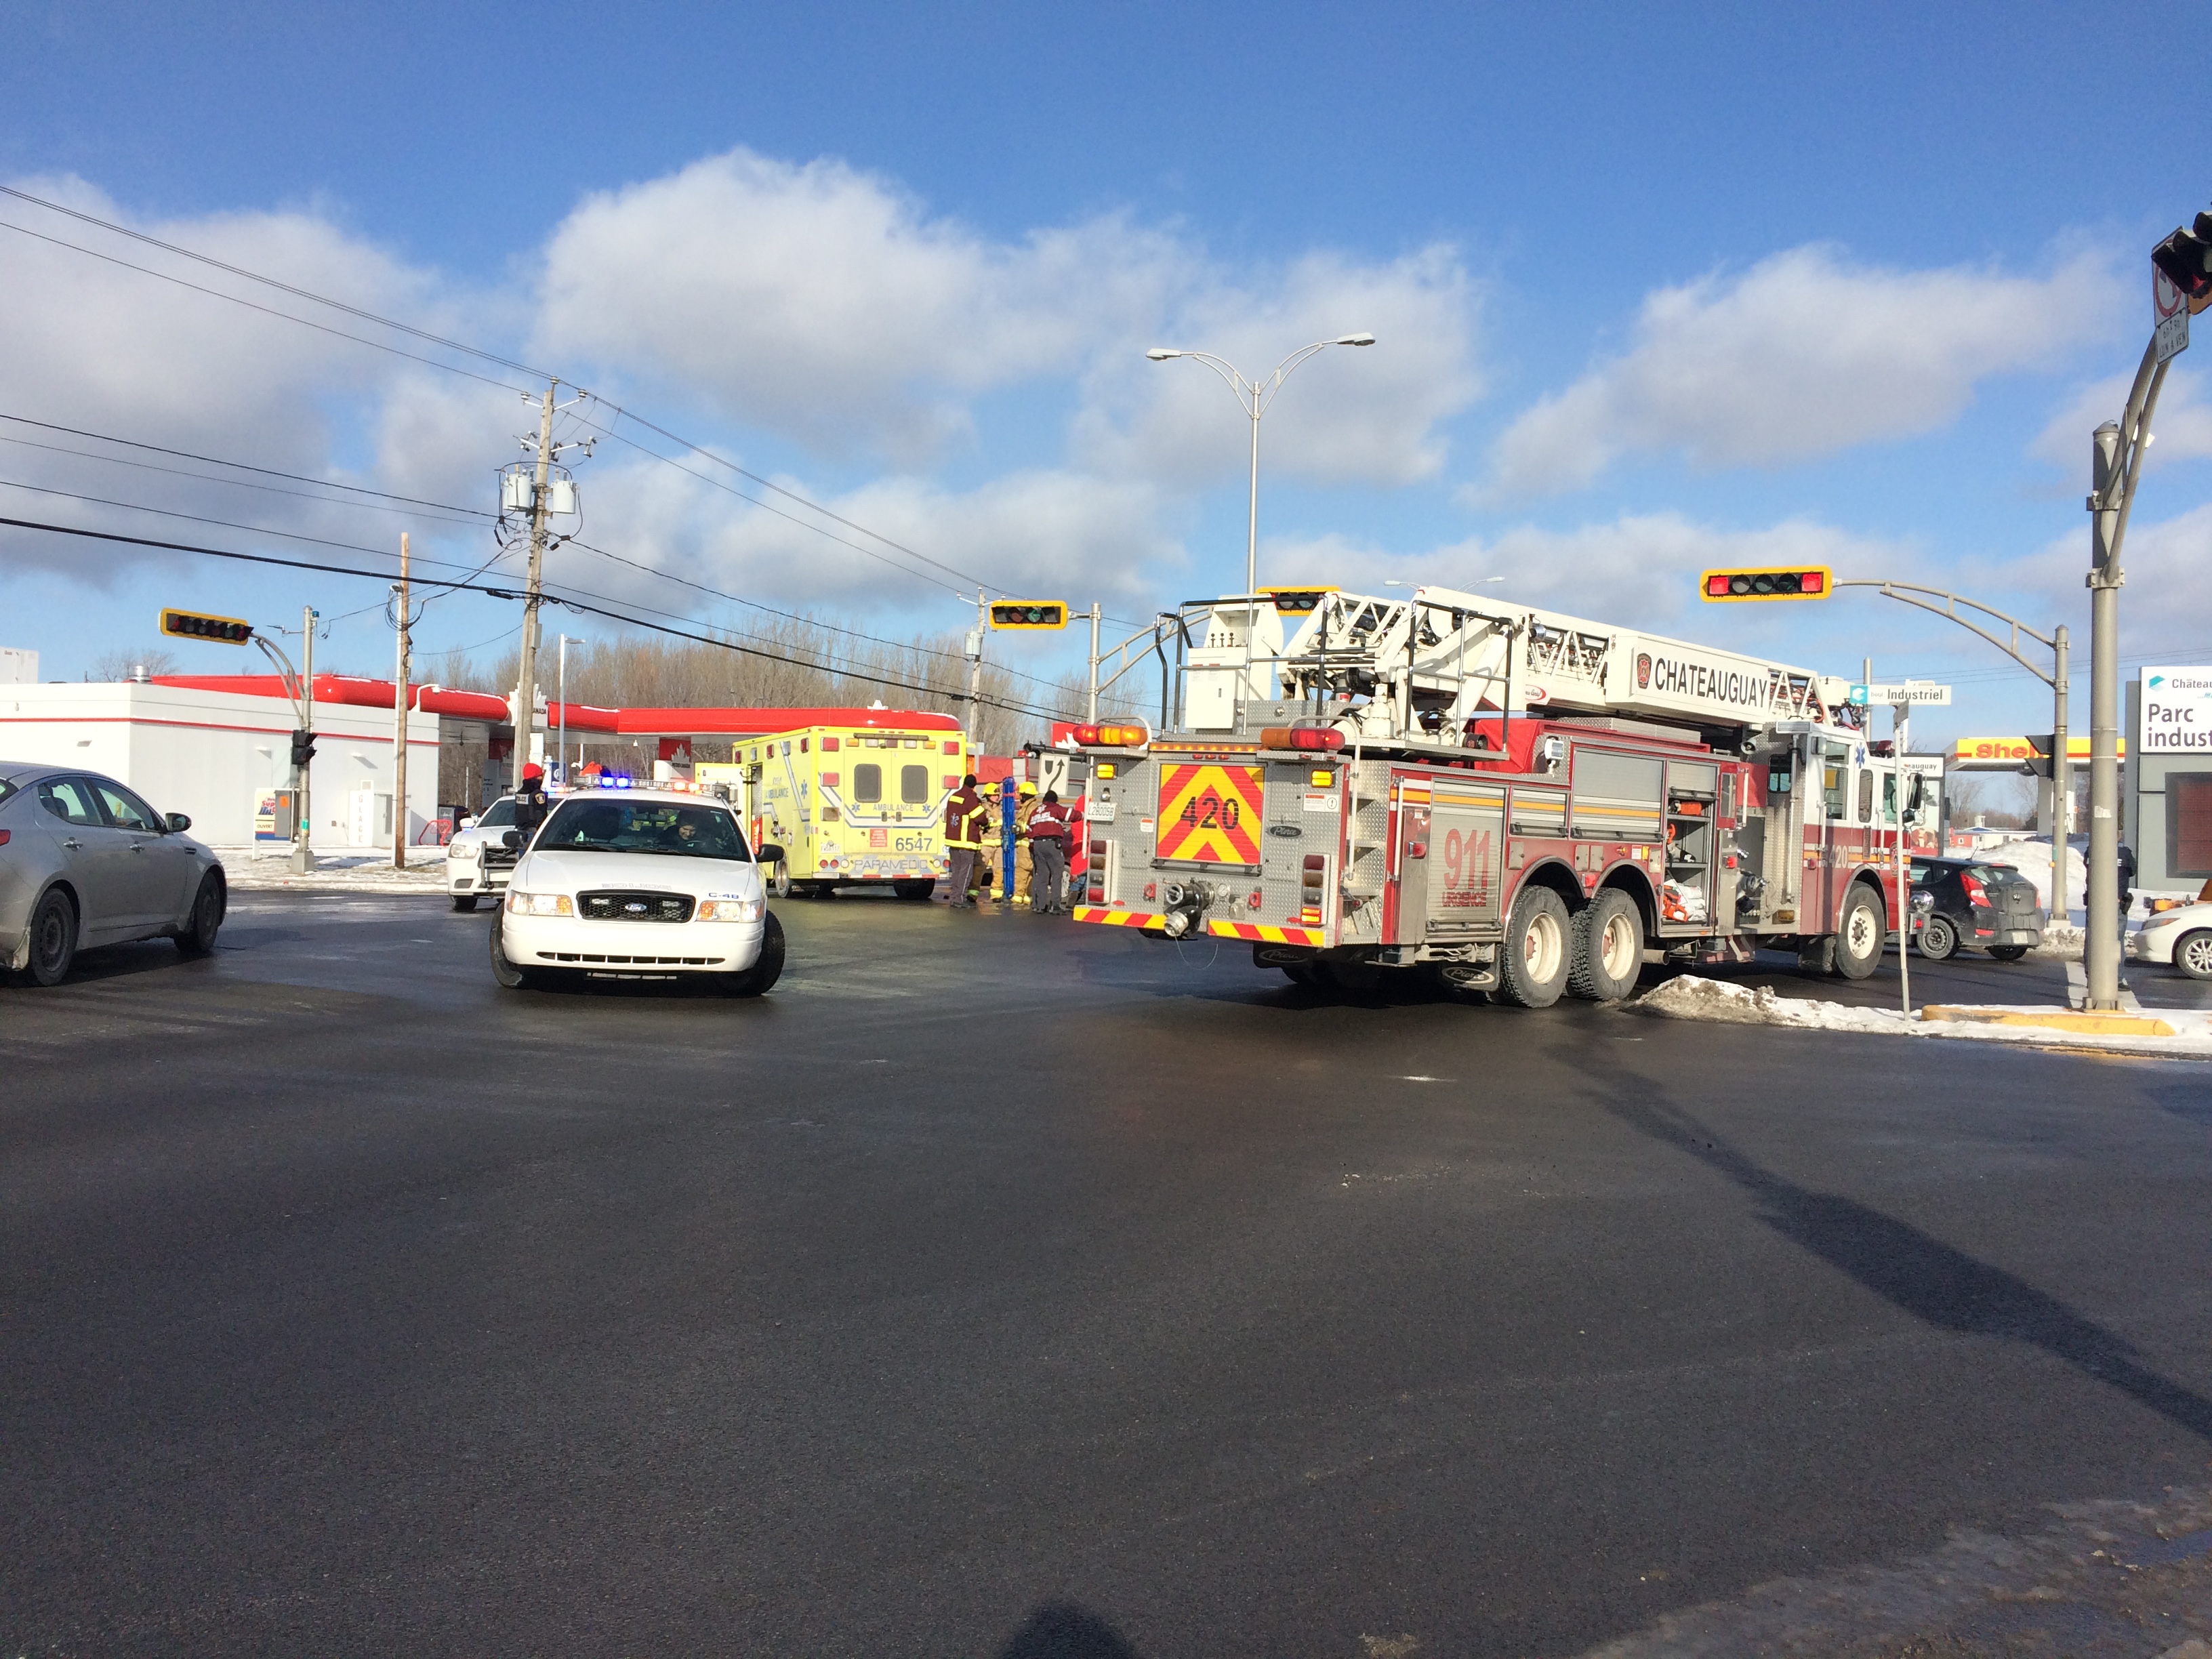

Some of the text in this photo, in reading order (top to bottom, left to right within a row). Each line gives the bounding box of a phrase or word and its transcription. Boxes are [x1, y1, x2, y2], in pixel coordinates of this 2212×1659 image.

[1655, 657, 1767, 708] CHATEAUGUAY
[1887, 689, 1943, 700] Industriel
[2148, 703, 2194, 722] Parc
[1976, 743, 2044, 758] Shel
[873, 804, 914, 812] AMBULANCE
[1180, 796, 1240, 830] 420
[895, 837, 933, 851] 6547
[854, 859, 928, 869] PARAMEDIC
[1443, 828, 1490, 890] 911
[1828, 844, 1847, 869] 420
[1442, 891, 1488, 907] URGENCE
